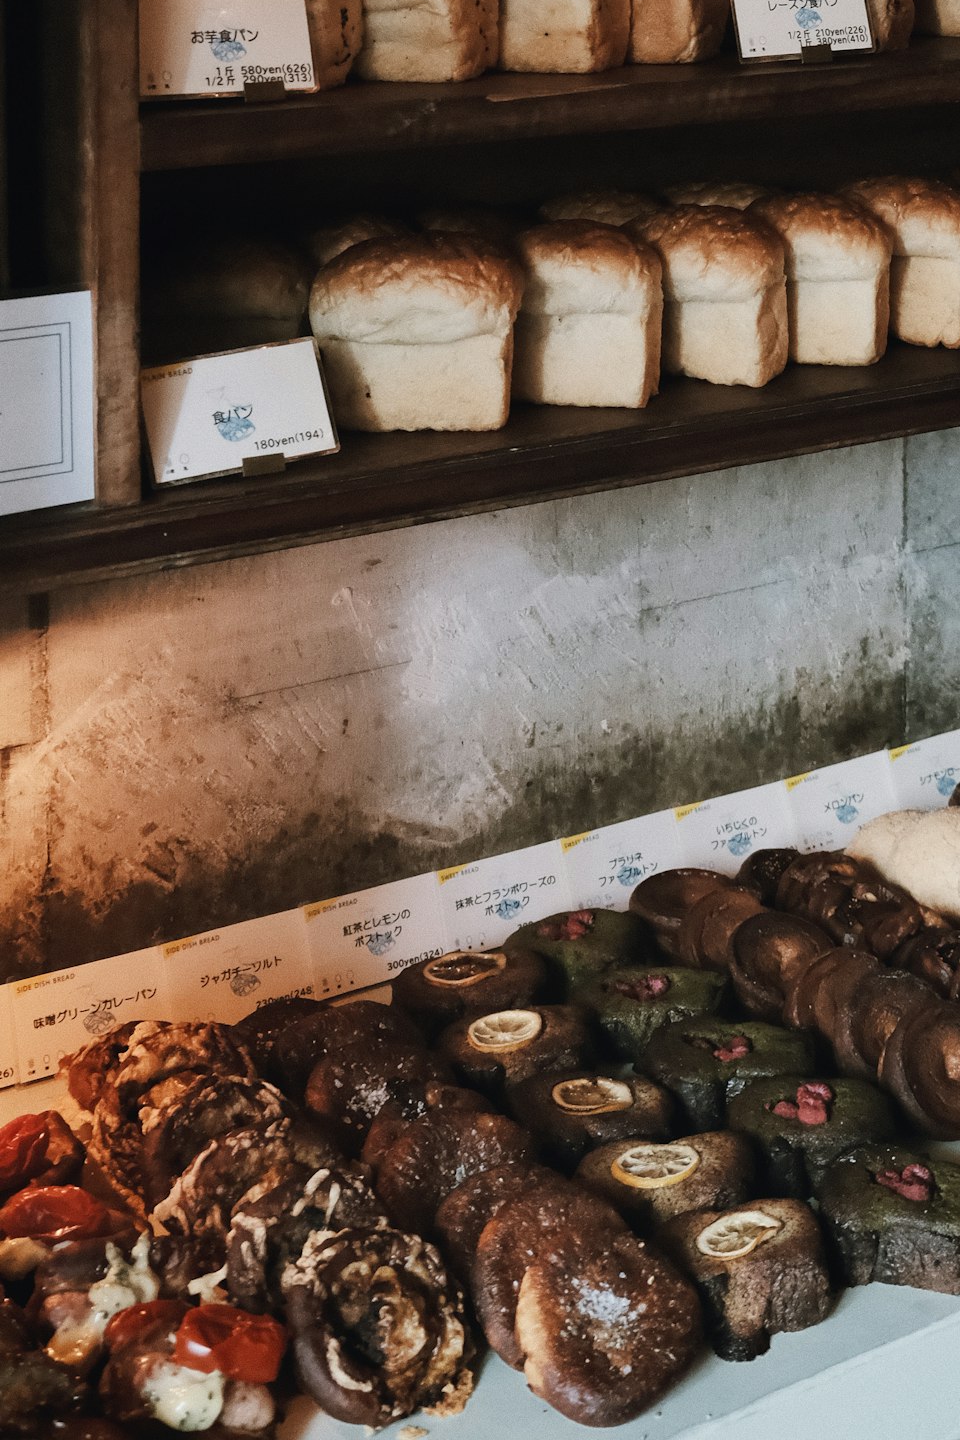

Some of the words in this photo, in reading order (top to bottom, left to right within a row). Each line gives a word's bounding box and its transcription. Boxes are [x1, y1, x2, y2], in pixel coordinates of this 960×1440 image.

[191, 29, 259, 44] お芋食パン
[815, 25, 867, 38] 210yen(226)
[241, 63, 311, 75] 580yen(626)
[168, 367, 193, 378] BREAD
[212, 407, 253, 425] 食パン
[254, 428, 324, 451] 180yen(194)
[824, 793, 864, 813] メロンパン
[716, 816, 757, 835] いちじくの
[711, 827, 767, 850] ファーブルトン
[440, 871, 458, 882] SWEET
[460, 866, 480, 876] BREAD
[599, 862, 658, 887] ファーブルトン
[338, 898, 358, 908] BREAD
[342, 908, 411, 936] 紅茶とレモンの
[165, 946, 180, 955] SIDE
[182, 941, 198, 951] DISH
[199, 934, 220, 945] BREAD
[387, 947, 443, 971] 300yen(324)
[16, 983, 32, 993] SIDE
[34, 979, 51, 989] DISH
[52, 973, 75, 984] BREAD
[256, 986, 314, 1008] 230en(248
[33, 988, 157, 1029] 味噌グリーンカレーパン
